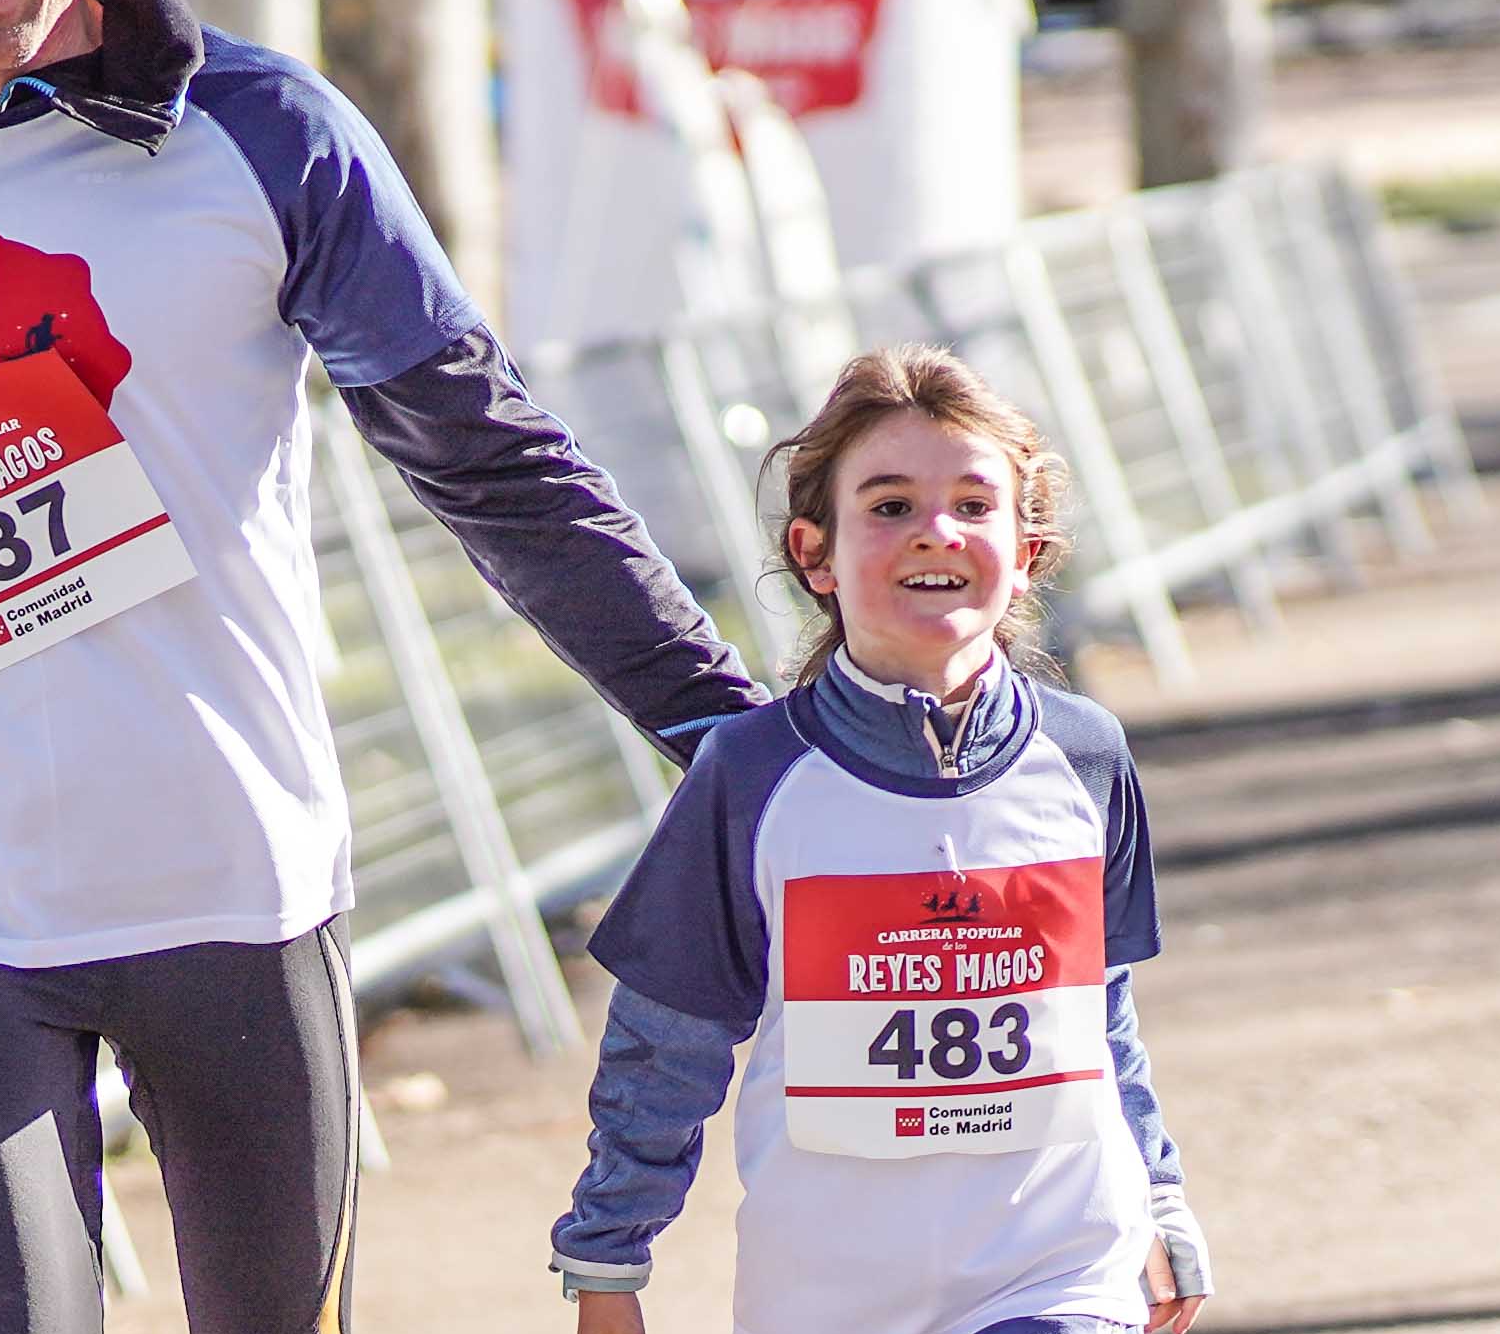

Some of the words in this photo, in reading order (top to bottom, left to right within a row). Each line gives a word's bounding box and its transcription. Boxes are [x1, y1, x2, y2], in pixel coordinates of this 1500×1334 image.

[6, 576, 86, 621] Comunidad
[14, 621, 34, 638] de
[38, 591, 93, 627] Madrid
[877, 928, 952, 944] CARRERA
[956, 927, 1023, 940] POPULAR
[942, 942, 954, 951] de
[955, 942, 967, 951] los
[848, 953, 942, 993] REYES
[955, 944, 1045, 993] MAGOS
[868, 1001, 1032, 1081] 483
[929, 1102, 1013, 1119] Comunidad
[929, 1123, 950, 1136] de
[956, 1118, 1013, 1134] Madrid
